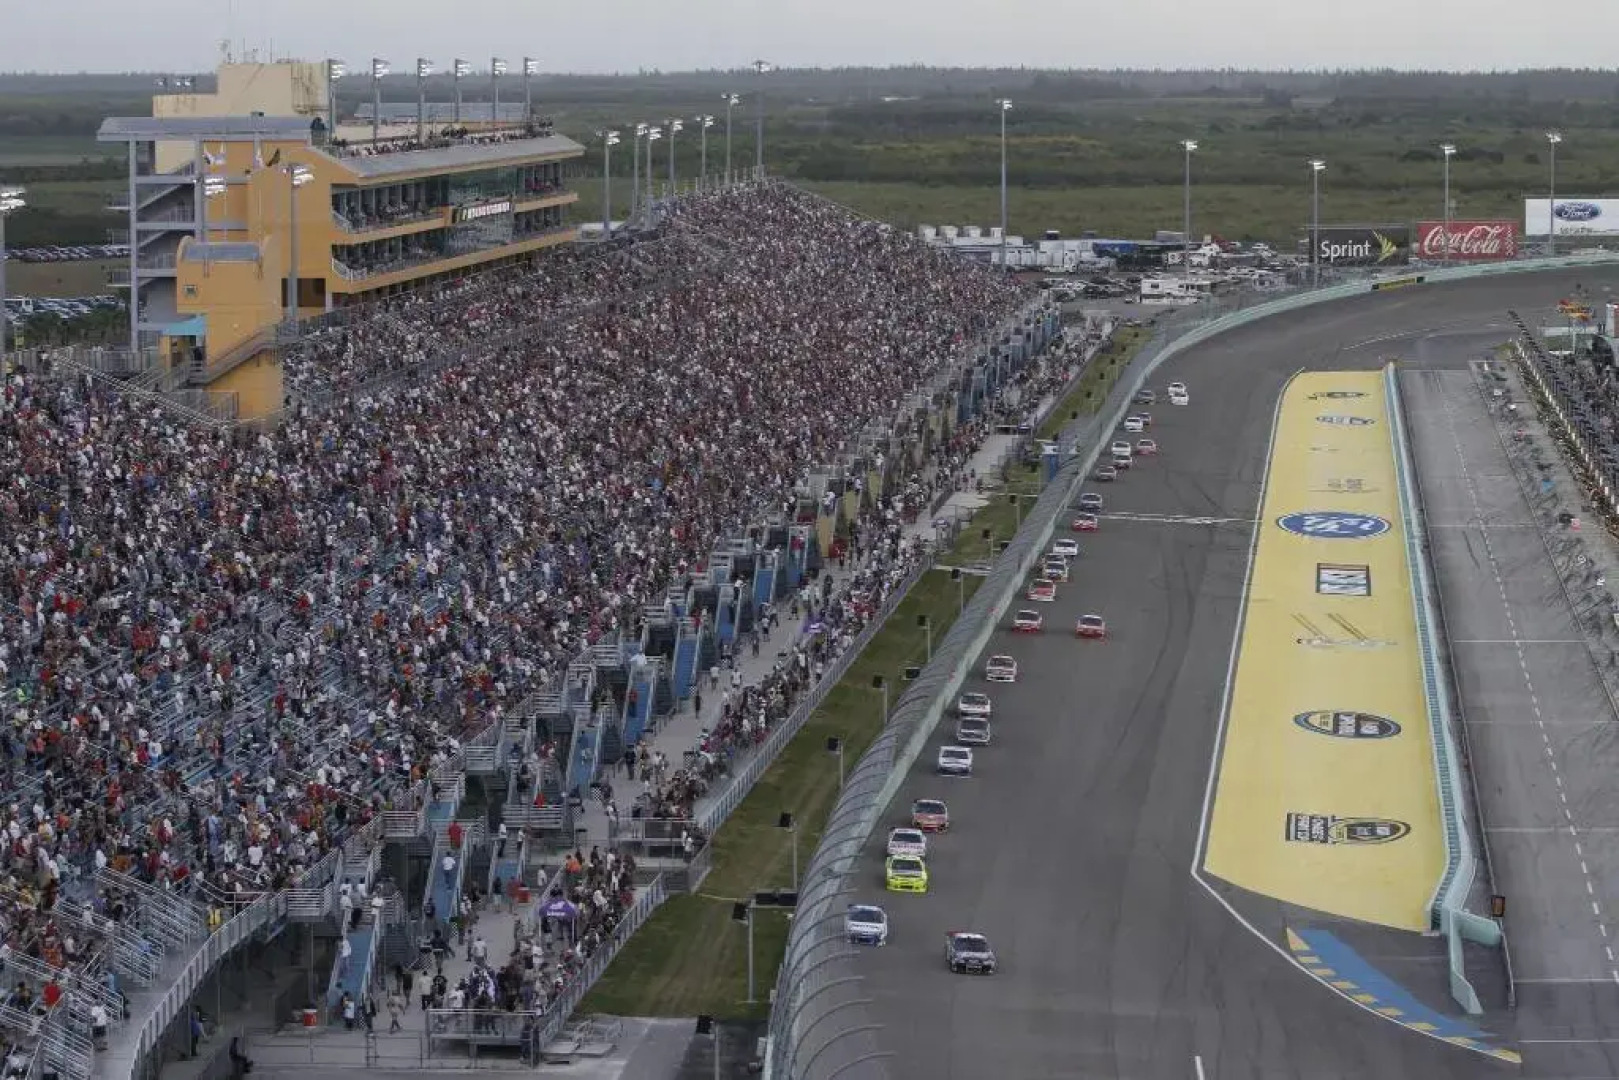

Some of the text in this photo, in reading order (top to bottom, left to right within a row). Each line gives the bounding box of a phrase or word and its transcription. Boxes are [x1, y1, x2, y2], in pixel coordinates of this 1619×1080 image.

[1562, 205, 1592, 218] Ford
[1321, 240, 1371, 262] Sprint
[1424, 225, 1505, 255] Coca-Cola
